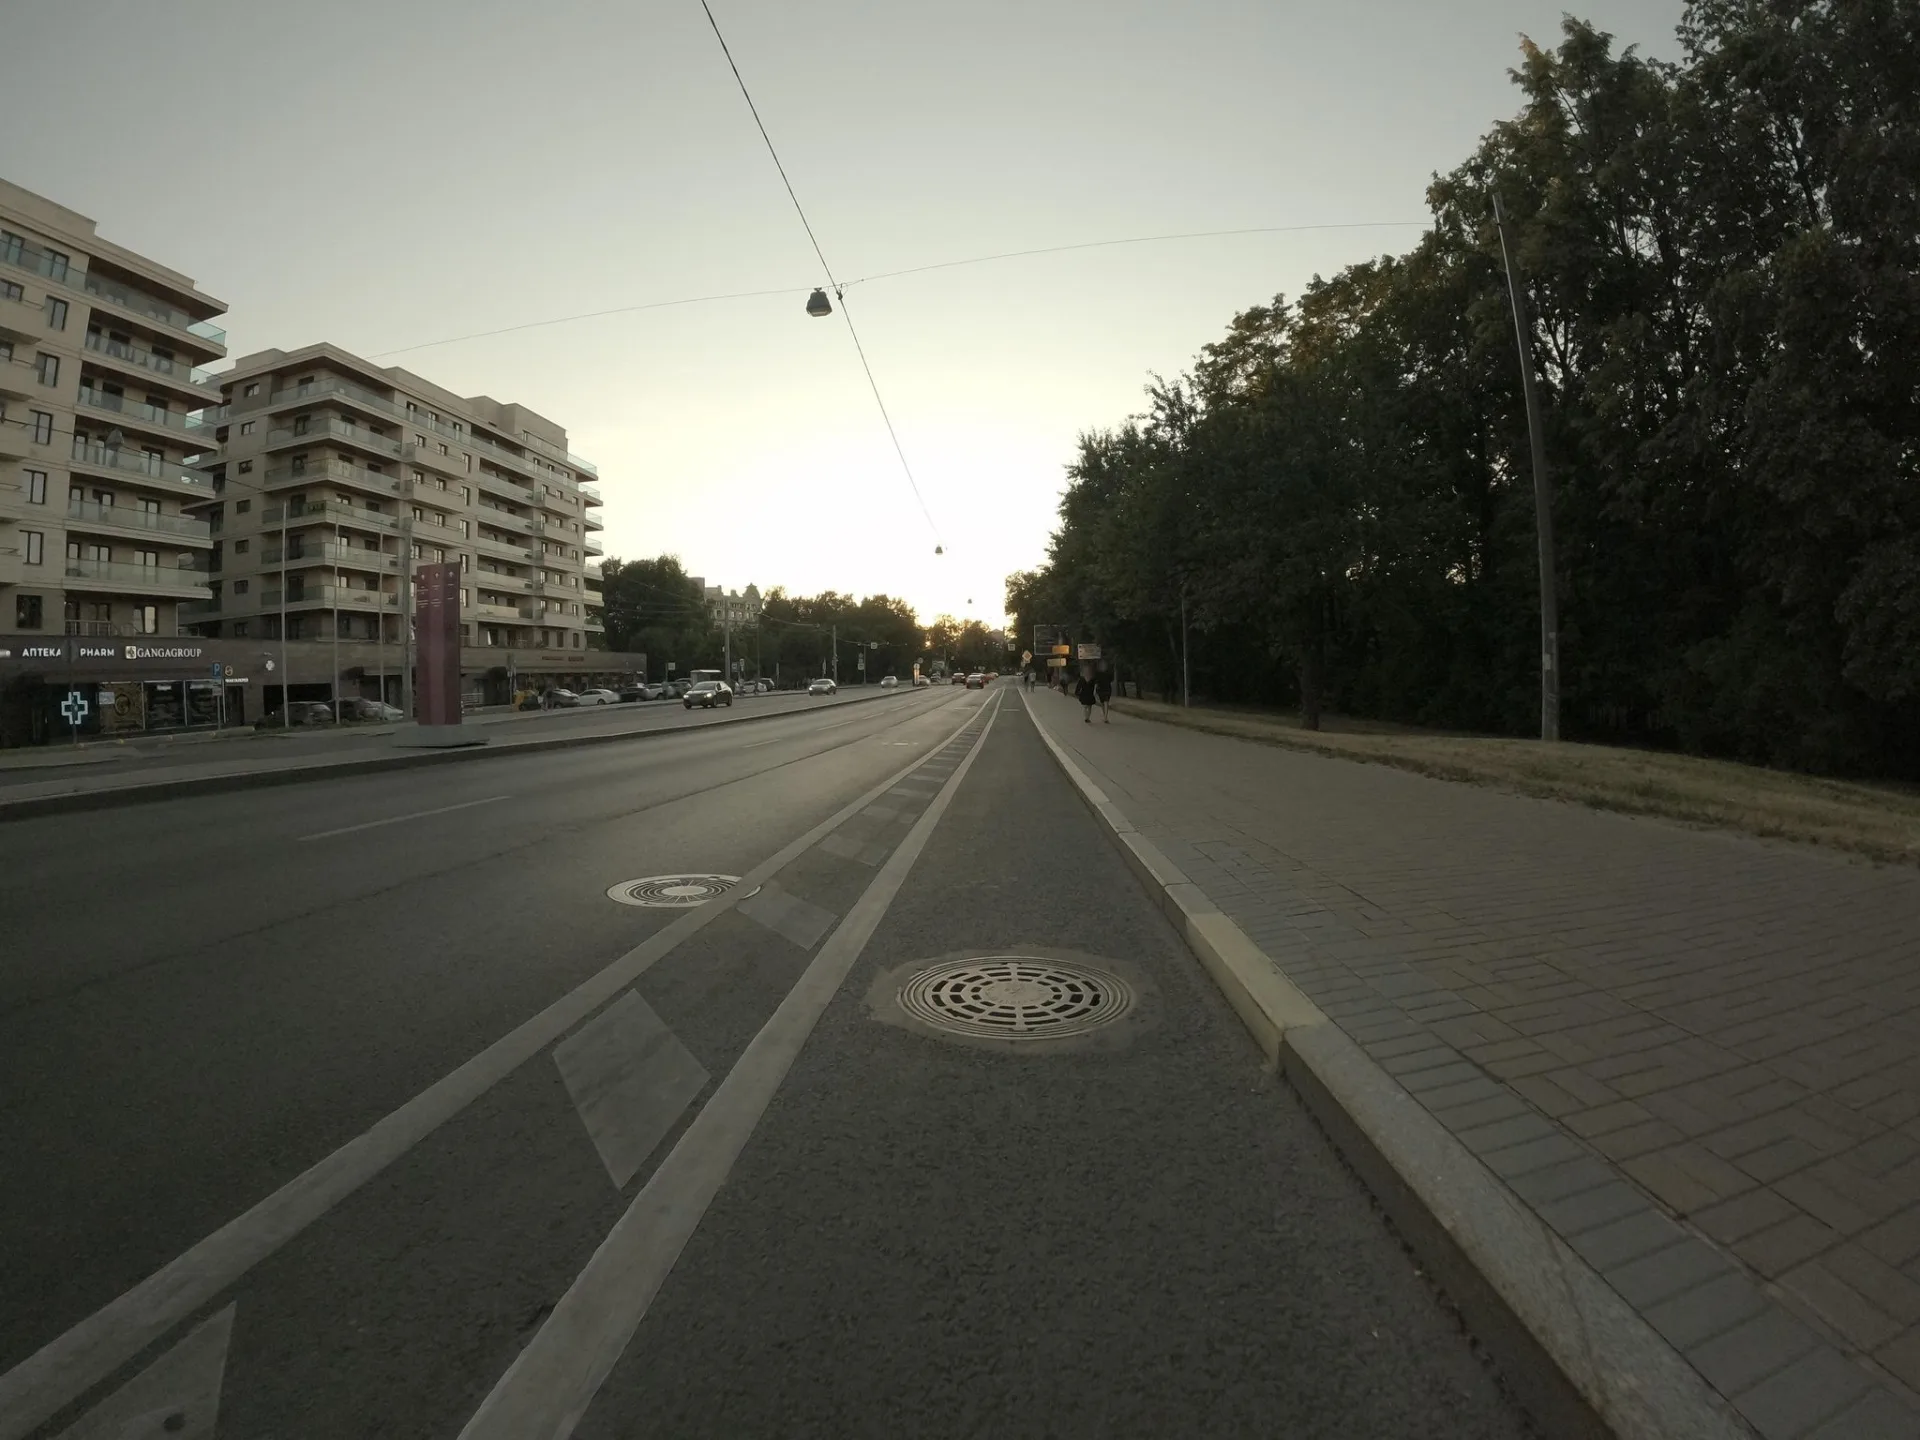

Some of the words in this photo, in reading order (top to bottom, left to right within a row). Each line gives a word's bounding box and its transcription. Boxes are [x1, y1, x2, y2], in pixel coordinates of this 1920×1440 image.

[80, 647, 115, 657] PHARM
[137, 648, 202, 658] GANGAGROUP
[214, 662, 221, 675] P
